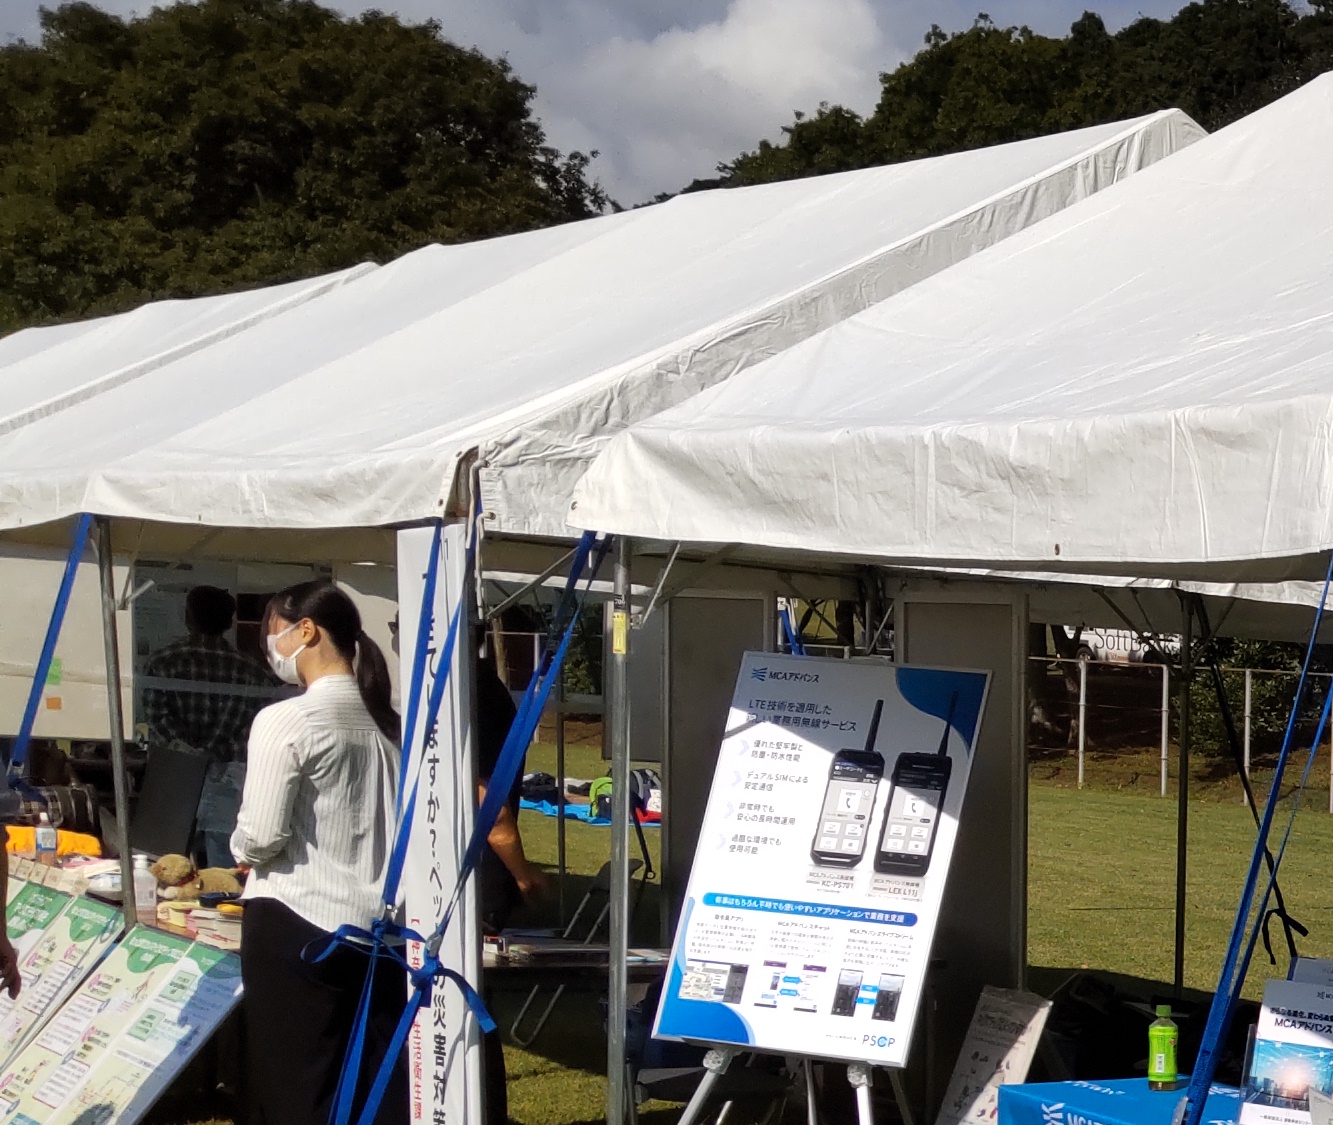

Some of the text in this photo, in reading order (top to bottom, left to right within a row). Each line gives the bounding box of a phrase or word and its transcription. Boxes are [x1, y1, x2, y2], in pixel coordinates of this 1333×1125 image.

[768, 671, 819, 683] MCAアドバンス
[1274, 1017, 1333, 1035] MCAアドバンス
[862, 1034, 896, 1048] PSCP
